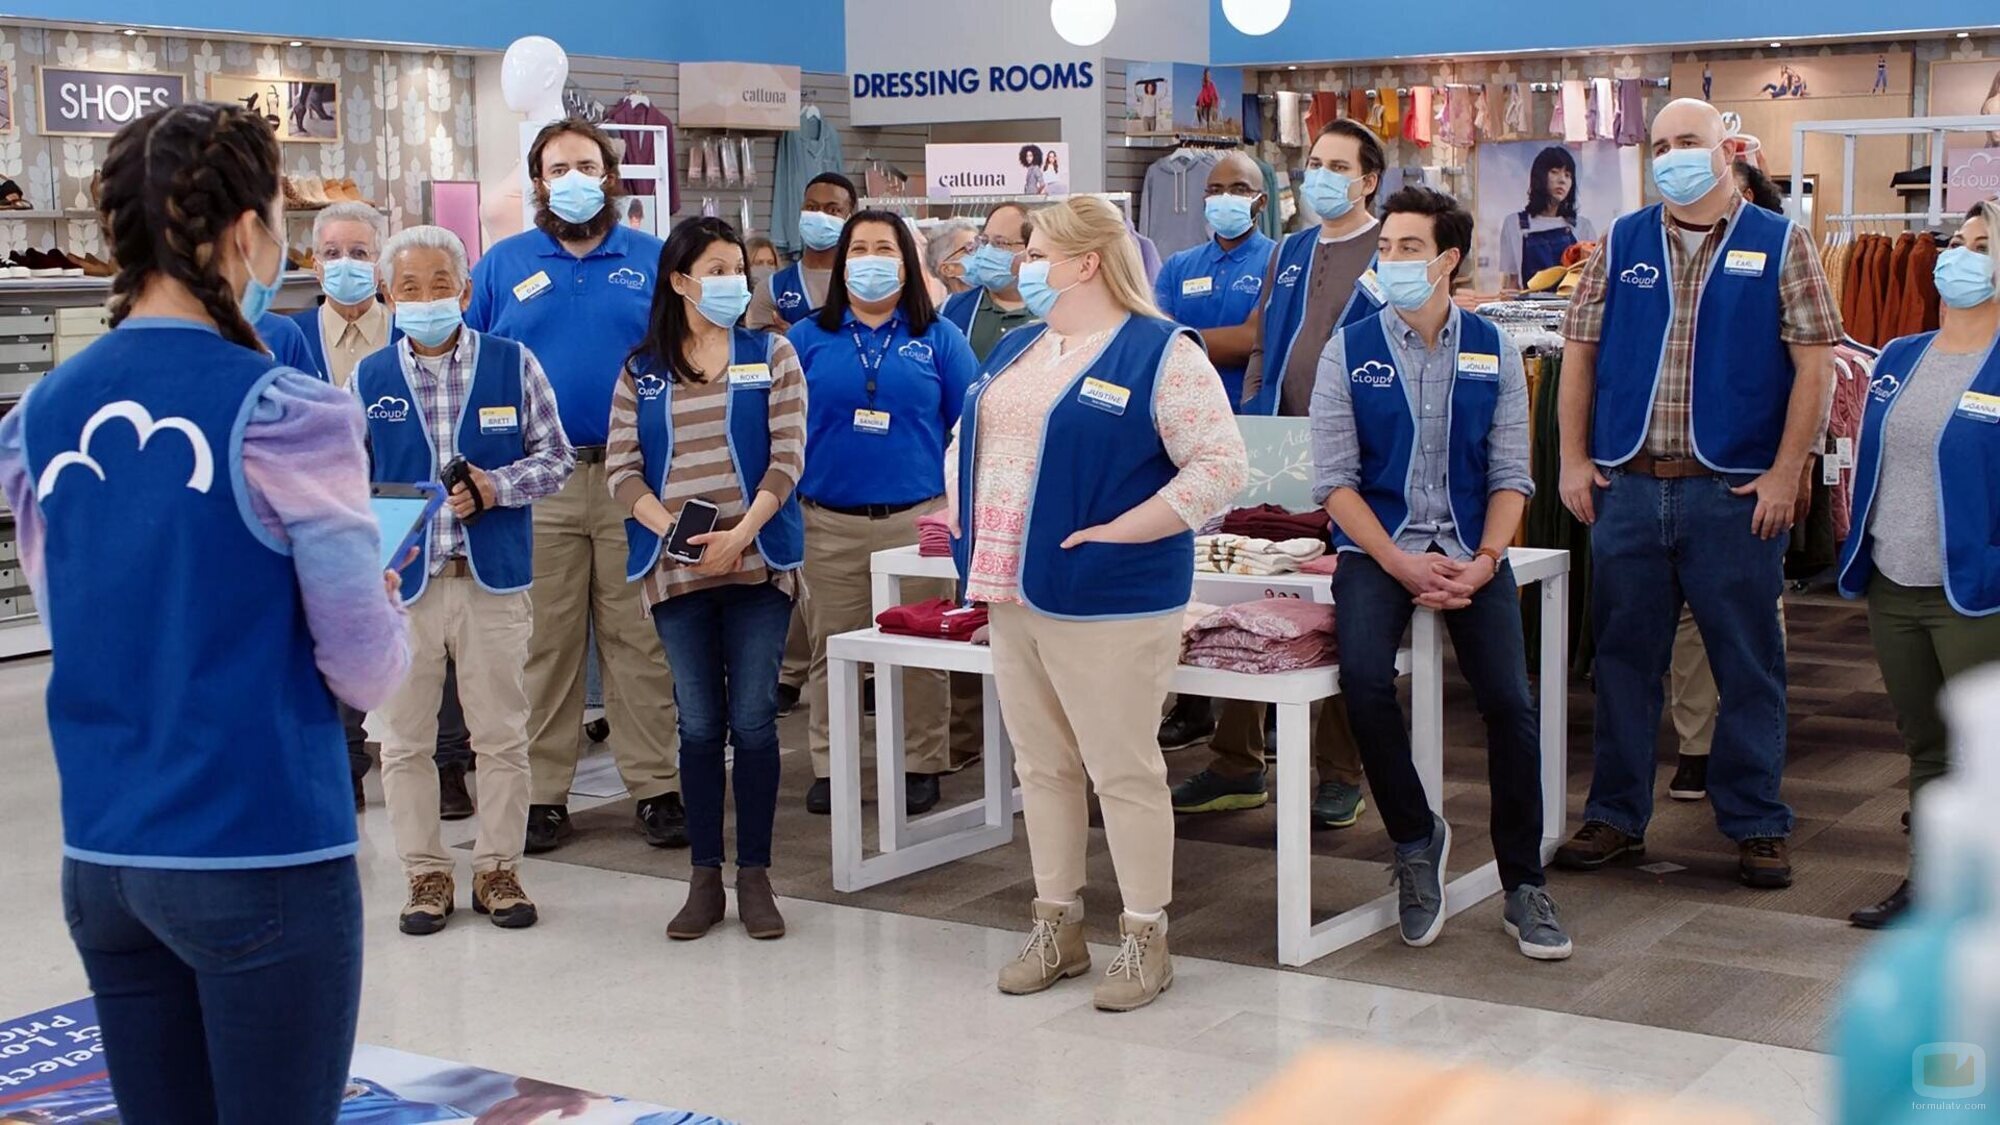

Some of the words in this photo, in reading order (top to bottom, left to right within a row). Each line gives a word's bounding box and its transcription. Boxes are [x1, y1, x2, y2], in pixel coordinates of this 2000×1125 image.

[853, 68, 980, 98] DRESSING
[989, 62, 1093, 92] ROOMS
[60, 82, 169, 122] SHOES
[742, 88, 787, 104] calluna
[938, 172, 1005, 188] calluna
